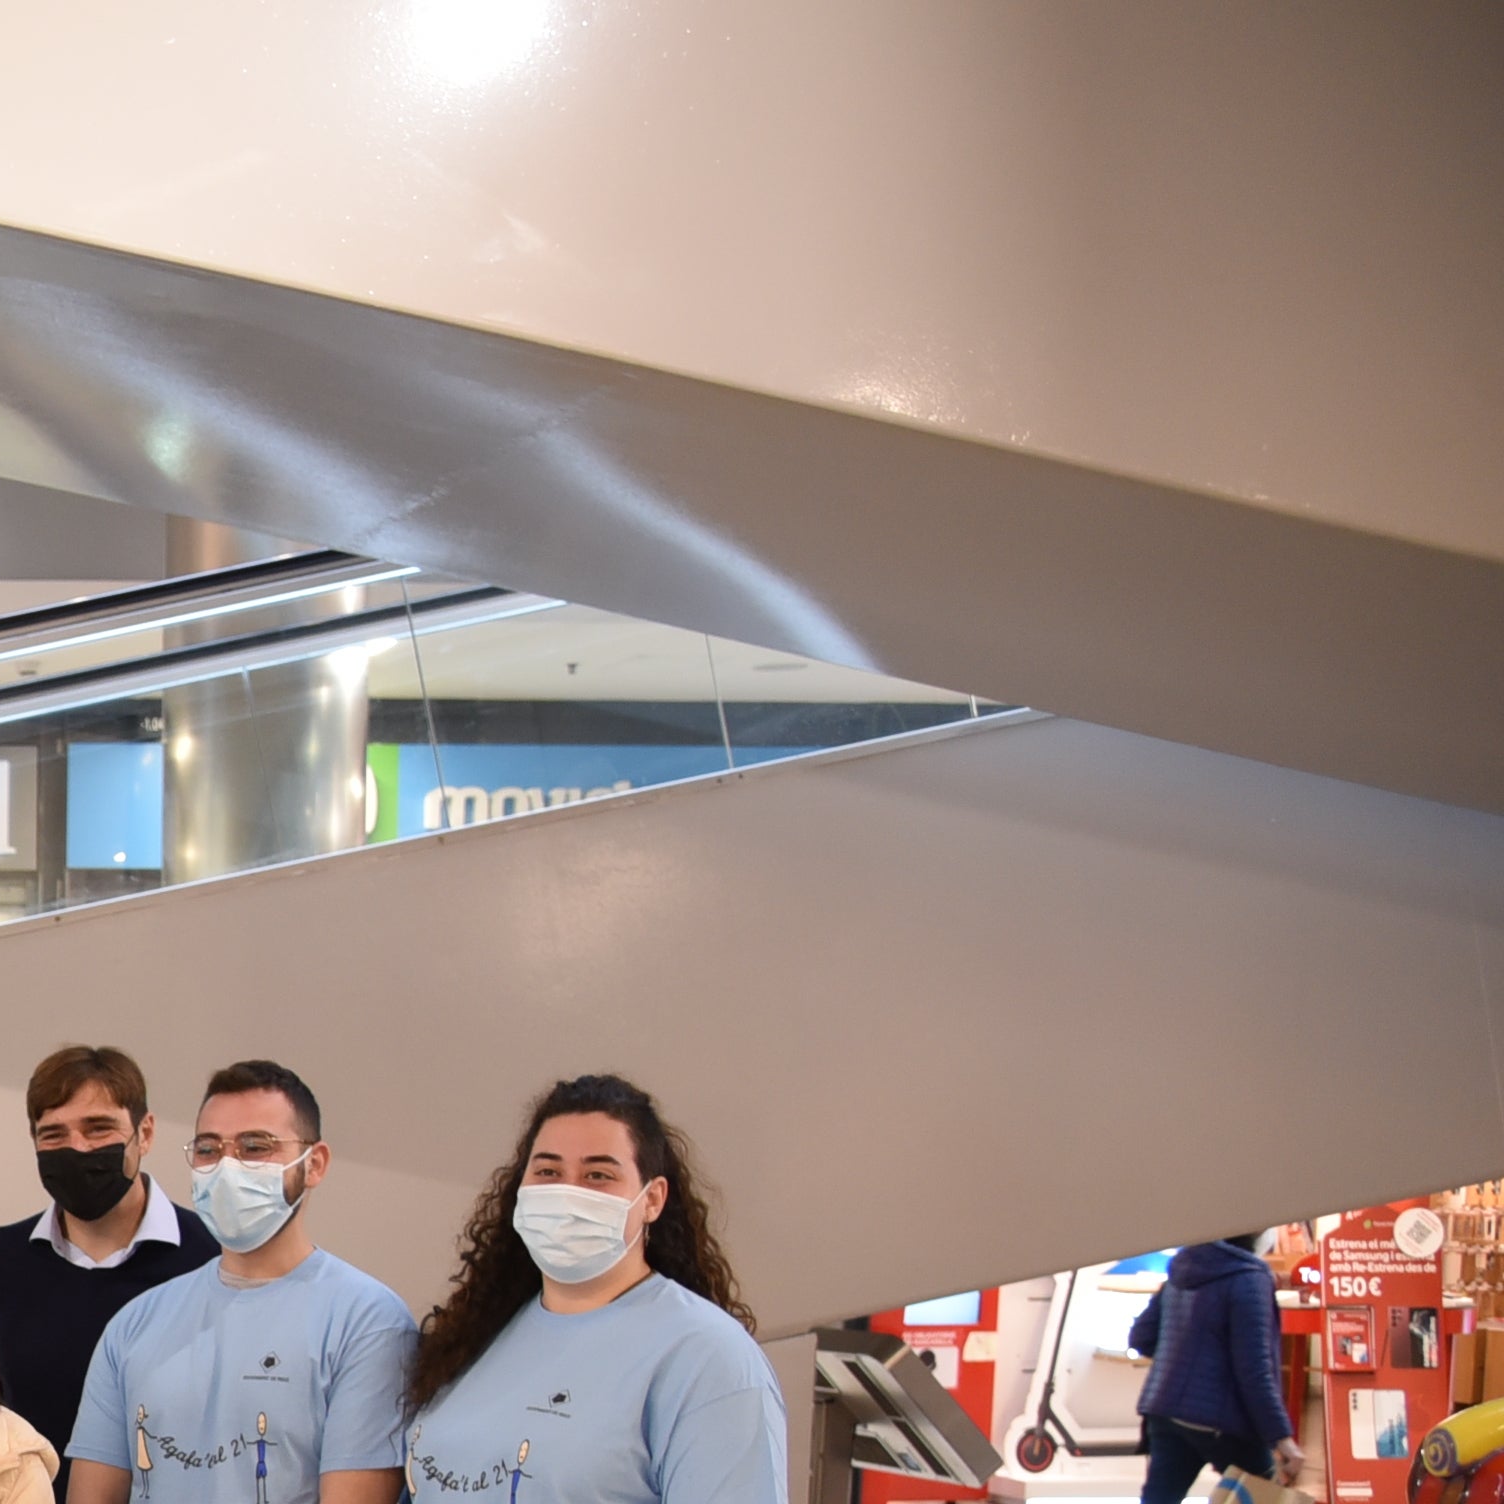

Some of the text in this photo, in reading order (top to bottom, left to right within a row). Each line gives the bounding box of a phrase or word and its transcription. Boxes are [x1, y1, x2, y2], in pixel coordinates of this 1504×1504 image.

[1343, 1250, 1390, 1262] Samsung
[1329, 1262, 1352, 1273] amb
[1329, 1276, 1382, 1297] 150 €
